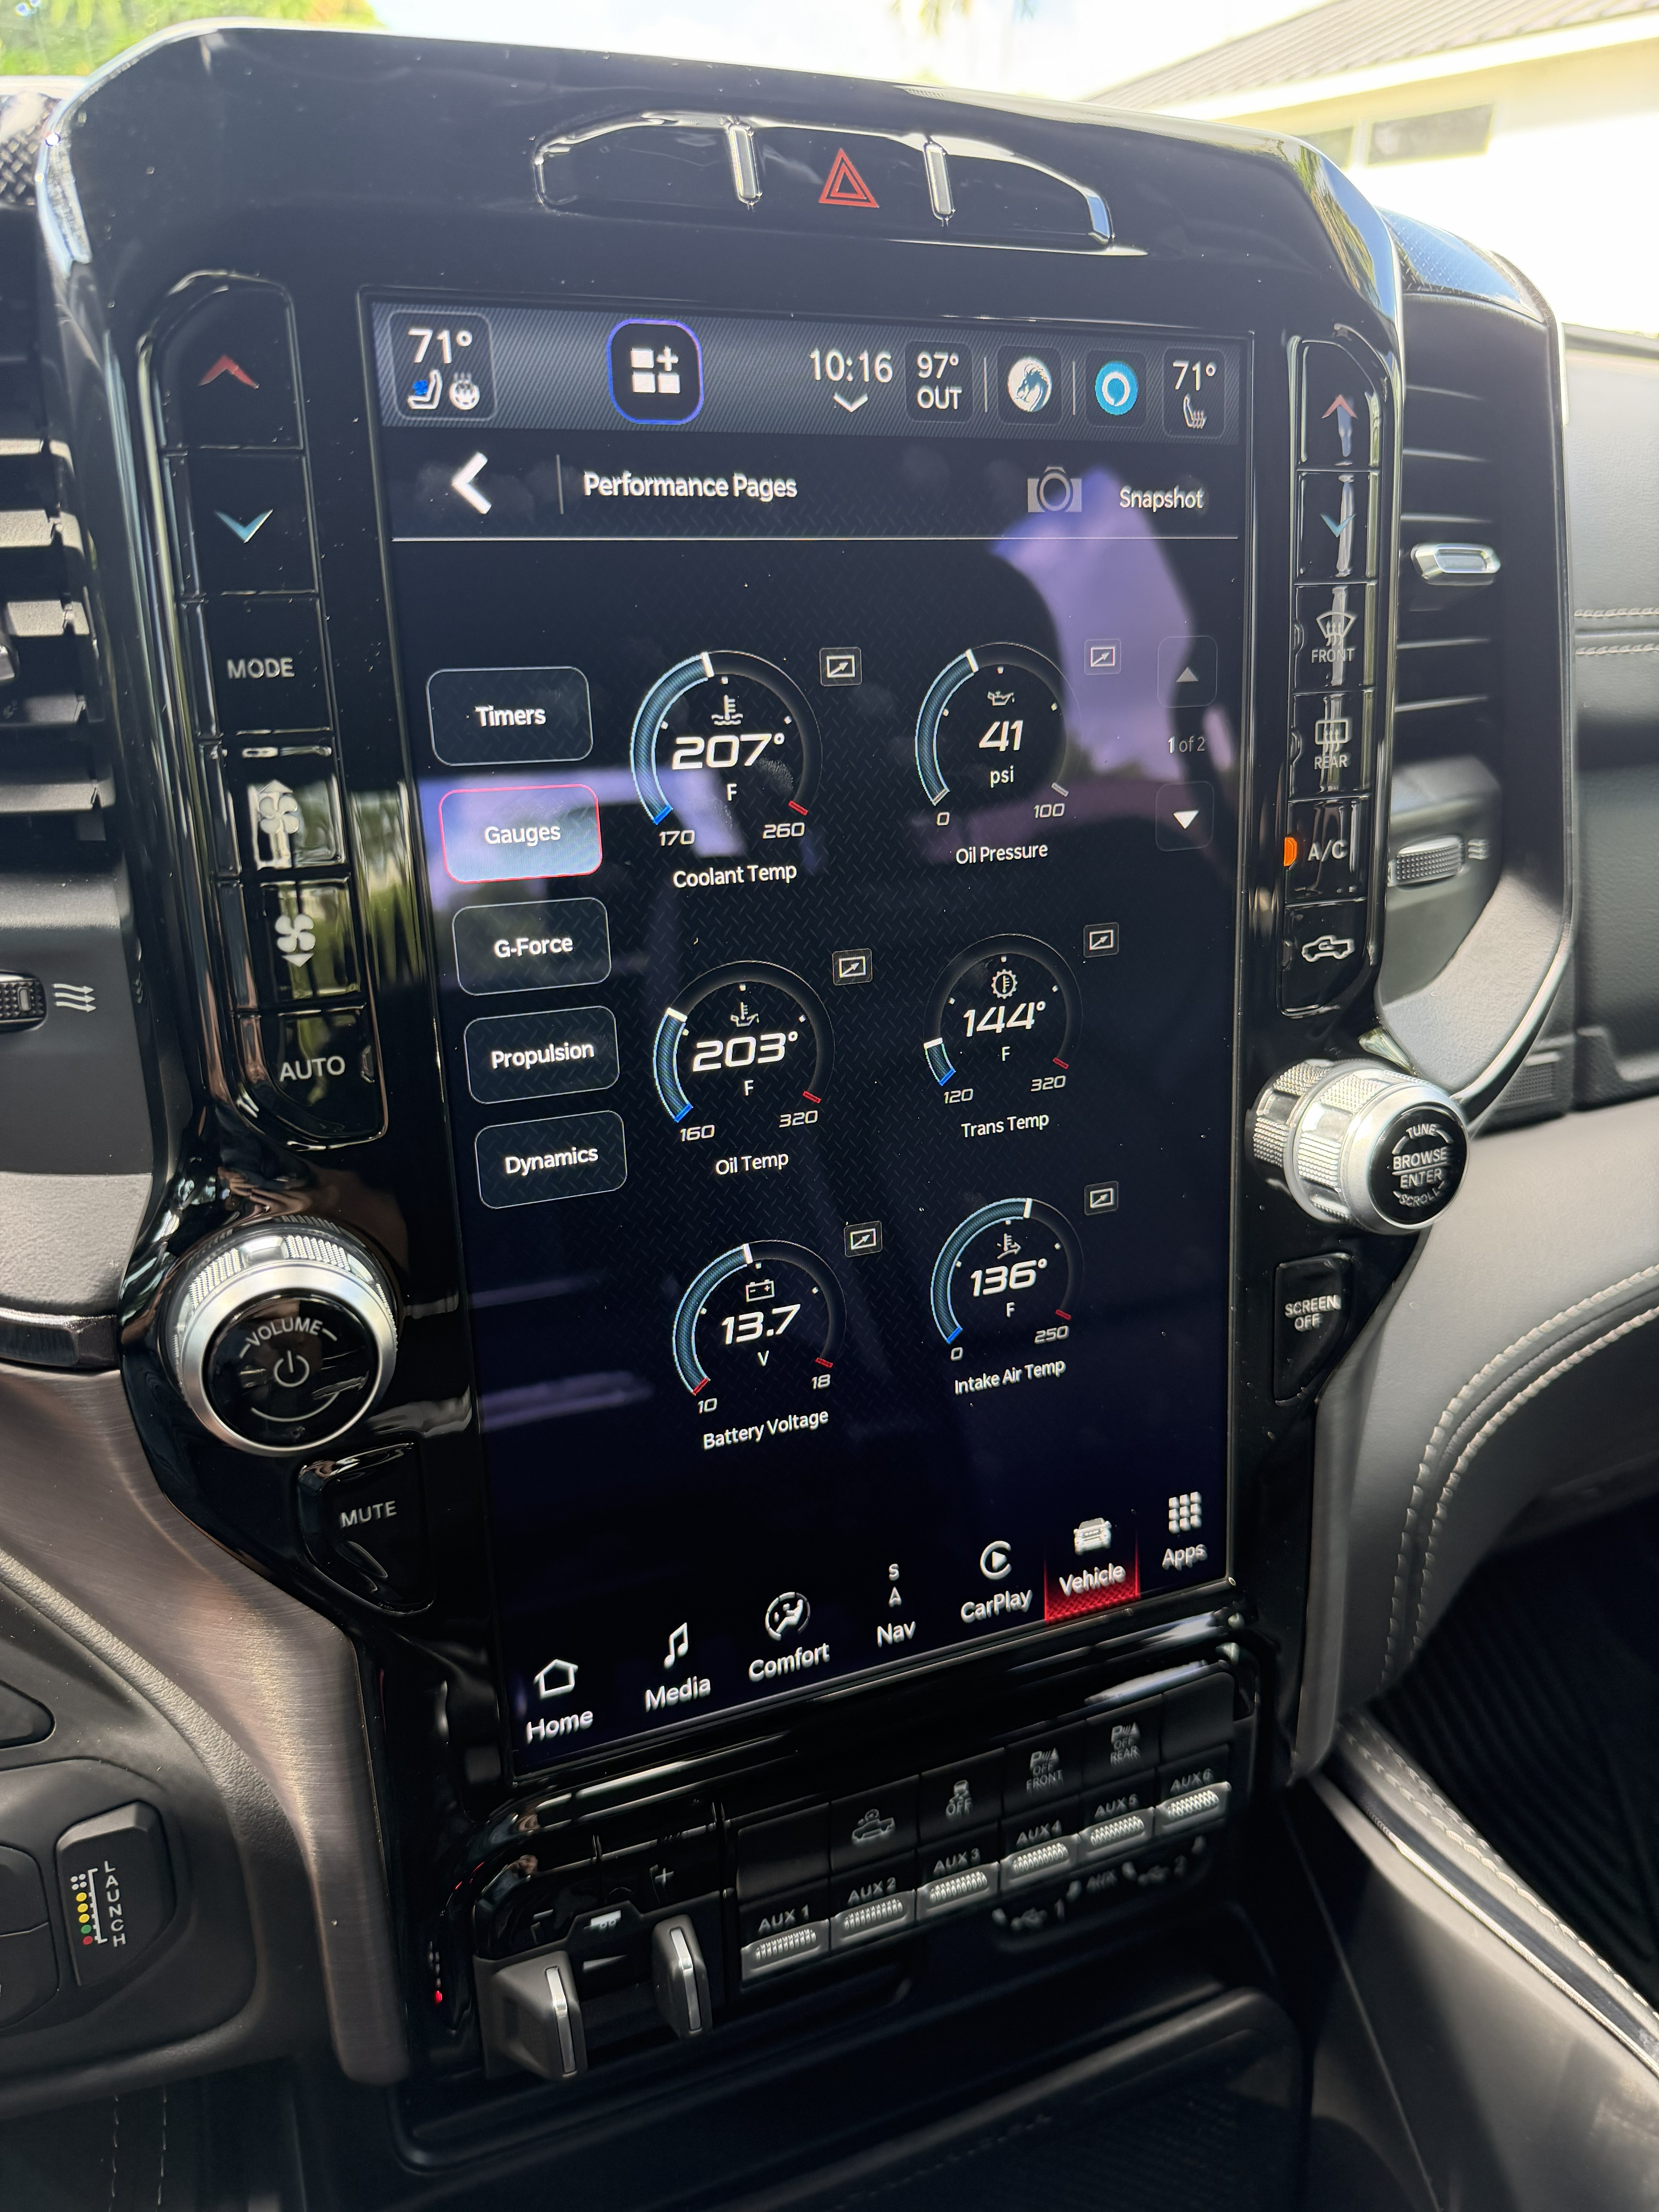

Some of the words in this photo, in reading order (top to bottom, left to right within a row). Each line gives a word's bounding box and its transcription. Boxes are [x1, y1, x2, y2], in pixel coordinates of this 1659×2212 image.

[408, 328, 473, 363] 71°
[810, 348, 893, 383] 10:16
[917, 352, 959, 379] 97°
[1172, 361, 1217, 392] 71°
[917, 387, 962, 410] OUT
[584, 471, 729, 497] Performance
[733, 472, 797, 502] Pages
[1119, 485, 1204, 512] Snapshot
[1311, 648, 1355, 664] FRONT
[228, 657, 295, 680] MODE
[475, 704, 546, 727] Timers
[979, 720, 1024, 751] 41
[1168, 737, 1175, 753] 1
[1179, 736, 1194, 753] of
[1197, 736, 1206, 751] 2
[672, 733, 785, 770] 207°
[1314, 755, 1348, 769] REAR
[990, 767, 1014, 788] psi
[727, 783, 737, 801] F
[937, 811, 950, 826] 0
[1034, 803, 1065, 818] 100
[484, 825, 561, 847] Gauges
[659, 830, 695, 846] 170
[763, 823, 805, 839] 260
[956, 847, 976, 864] Oil
[981, 843, 1048, 862] Pressure
[1308, 840, 1348, 861] A/C
[673, 867, 744, 888] Coolant
[747, 864, 797, 883] Temp
[494, 937, 573, 958] G-Force
[963, 1001, 1046, 1037] 144°
[491, 1042, 594, 1069] Propulsion
[693, 1031, 798, 1072] 203°
[1001, 1046, 1010, 1061] F
[280, 1056, 346, 1082] AUTO
[744, 1080, 754, 1096] F
[1031, 1075, 1066, 1092] 320
[943, 1088, 974, 1104] 120
[779, 1110, 818, 1128] 320
[962, 1120, 1004, 1137] Trans
[1007, 1115, 1050, 1131] Temp
[680, 1125, 715, 1142] 160
[1406, 1123, 1441, 1139] TUNE
[505, 1147, 598, 1176] Dynamics
[716, 1158, 737, 1175] Oil
[742, 1153, 789, 1171] Temp
[1393, 1147, 1449, 1170] BROWSE
[1400, 1168, 1444, 1189] ENTER
[1399, 1187, 1441, 1207] SCROLL
[970, 1258, 1048, 1297] 136°
[1006, 1302, 1015, 1317] F
[1285, 1295, 1341, 1317] SCREEN
[245, 1317, 323, 1347] VOLUME
[721, 1304, 801, 1345] 13.7
[1294, 1314, 1321, 1332] OFF
[1035, 1325, 1069, 1345] 250
[757, 1350, 769, 1367] V
[951, 1347, 963, 1361] 0
[812, 1374, 831, 1389] 18
[955, 1373, 1000, 1395] Intake
[1003, 1367, 1023, 1385] Air
[1024, 1360, 1066, 1379] Temp
[698, 1398, 718, 1414] 10
[703, 1425, 764, 1450] Battery
[767, 1411, 829, 1435] Voltage
[340, 1500, 397, 1528] MUTE
[1162, 1544, 1207, 1571] Apps
[889, 1563, 900, 1581] S
[1059, 1563, 1126, 1597] Vehicle
[961, 1589, 1033, 1623] CarPlay
[877, 1621, 916, 1647] Nav
[749, 1643, 830, 1682] Comfort
[645, 1676, 711, 1712] Media
[526, 1710, 594, 1745] Home
[1110, 1745, 1140, 1764] REAR
[1026, 1769, 1063, 1791] FRONT
[1170, 1772, 1201, 1793] AUX
[946, 1798, 972, 1819] OFF
[1094, 1797, 1127, 1819] AUX
[1016, 1824, 1050, 1847] AUX
[933, 1851, 968, 1876] AUX
[971, 1848, 981, 1864] 3
[848, 1881, 884, 1905] AUX
[887, 1877, 896, 1893] 2
[104, 1860, 126, 1948] LAUNCH
[758, 1909, 797, 1934] AUX
[801, 1904, 809, 1920] 1
